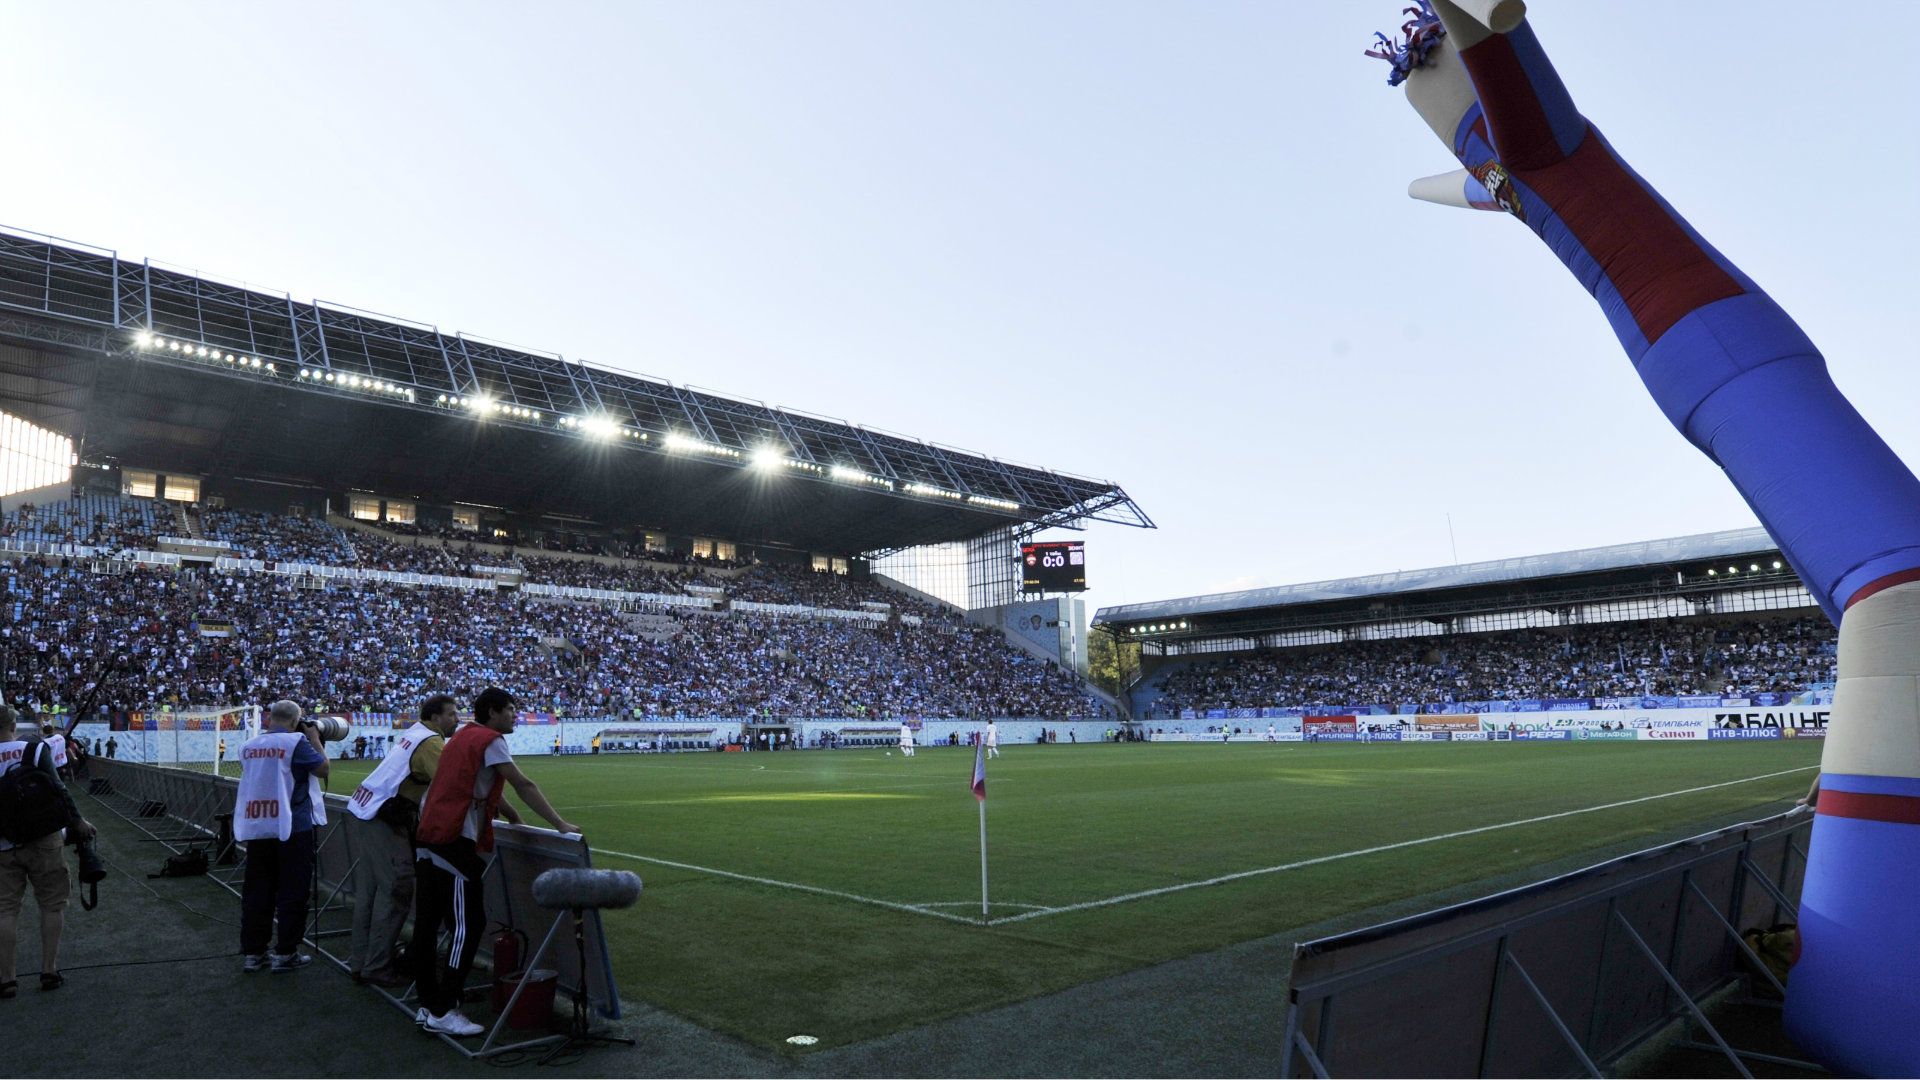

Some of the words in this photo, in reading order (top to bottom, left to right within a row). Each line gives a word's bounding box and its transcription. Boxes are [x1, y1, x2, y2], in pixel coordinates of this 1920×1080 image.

[1042, 555, 1065, 568] 0:0
[1653, 720, 1703, 728] ТЕМПБАНК
[1528, 731, 1566, 739] PEPSI
[1648, 730, 1696, 738] Canon
[1712, 729, 1777, 738] НТВ-ПЛЮС
